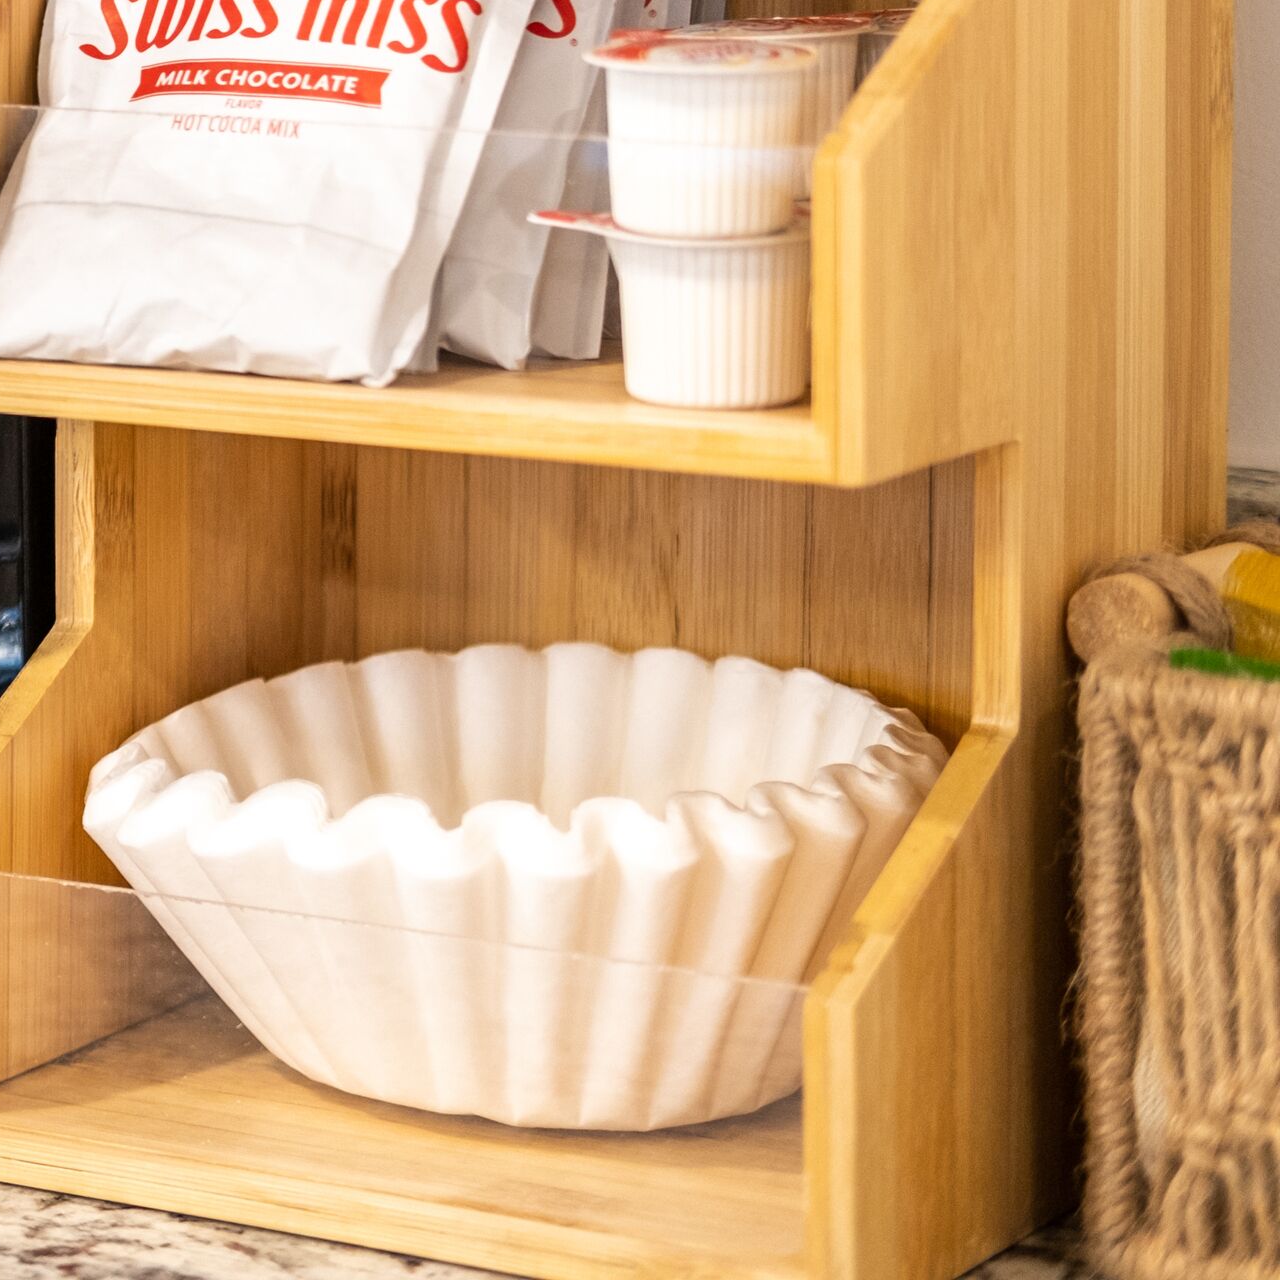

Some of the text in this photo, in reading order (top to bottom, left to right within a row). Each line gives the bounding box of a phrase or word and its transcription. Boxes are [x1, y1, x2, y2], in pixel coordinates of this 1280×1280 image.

[155, 68, 359, 96] MILK CHOCOLATE
[225, 98, 263, 110] FLAVOR
[171, 113, 301, 140] HOT COCOA MIX
